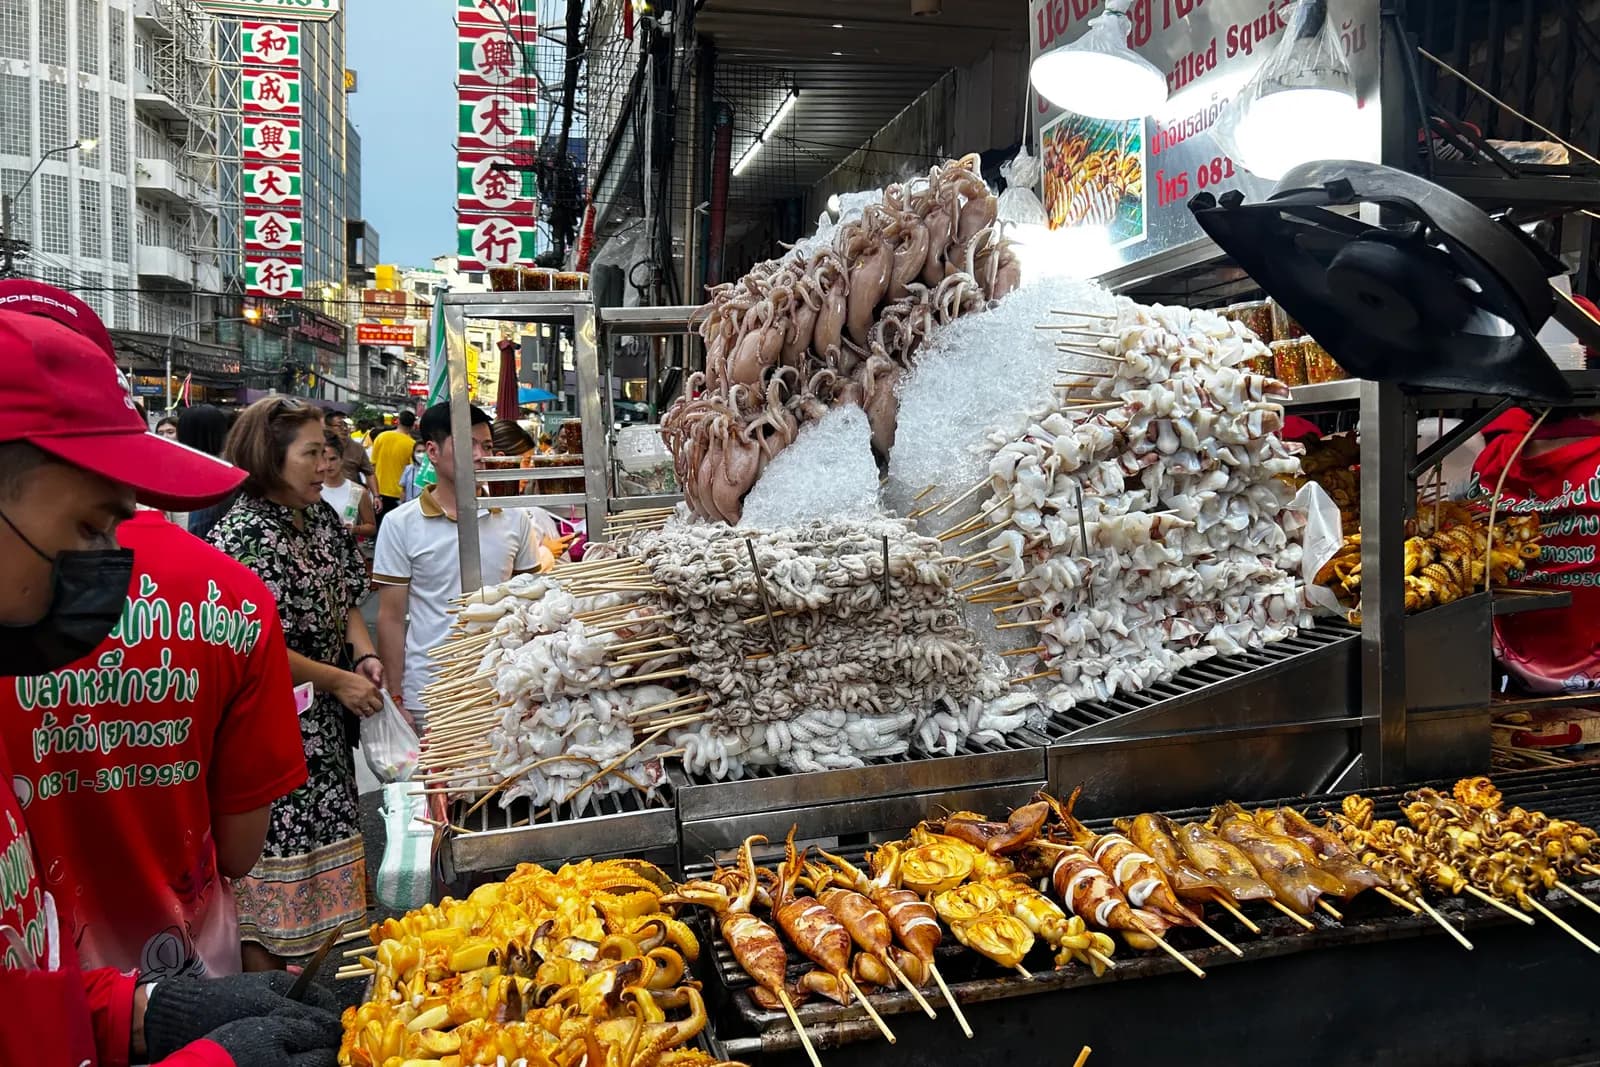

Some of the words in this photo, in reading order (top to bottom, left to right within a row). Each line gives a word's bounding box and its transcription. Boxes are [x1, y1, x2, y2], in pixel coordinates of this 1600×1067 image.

[1166, 36, 1218, 95] rilled
[256, 29, 289, 292] 和成興大金行
[1155, 169, 1188, 207] โทร
[177, 601, 196, 641] &
[37, 760, 201, 801] 081-3019950
